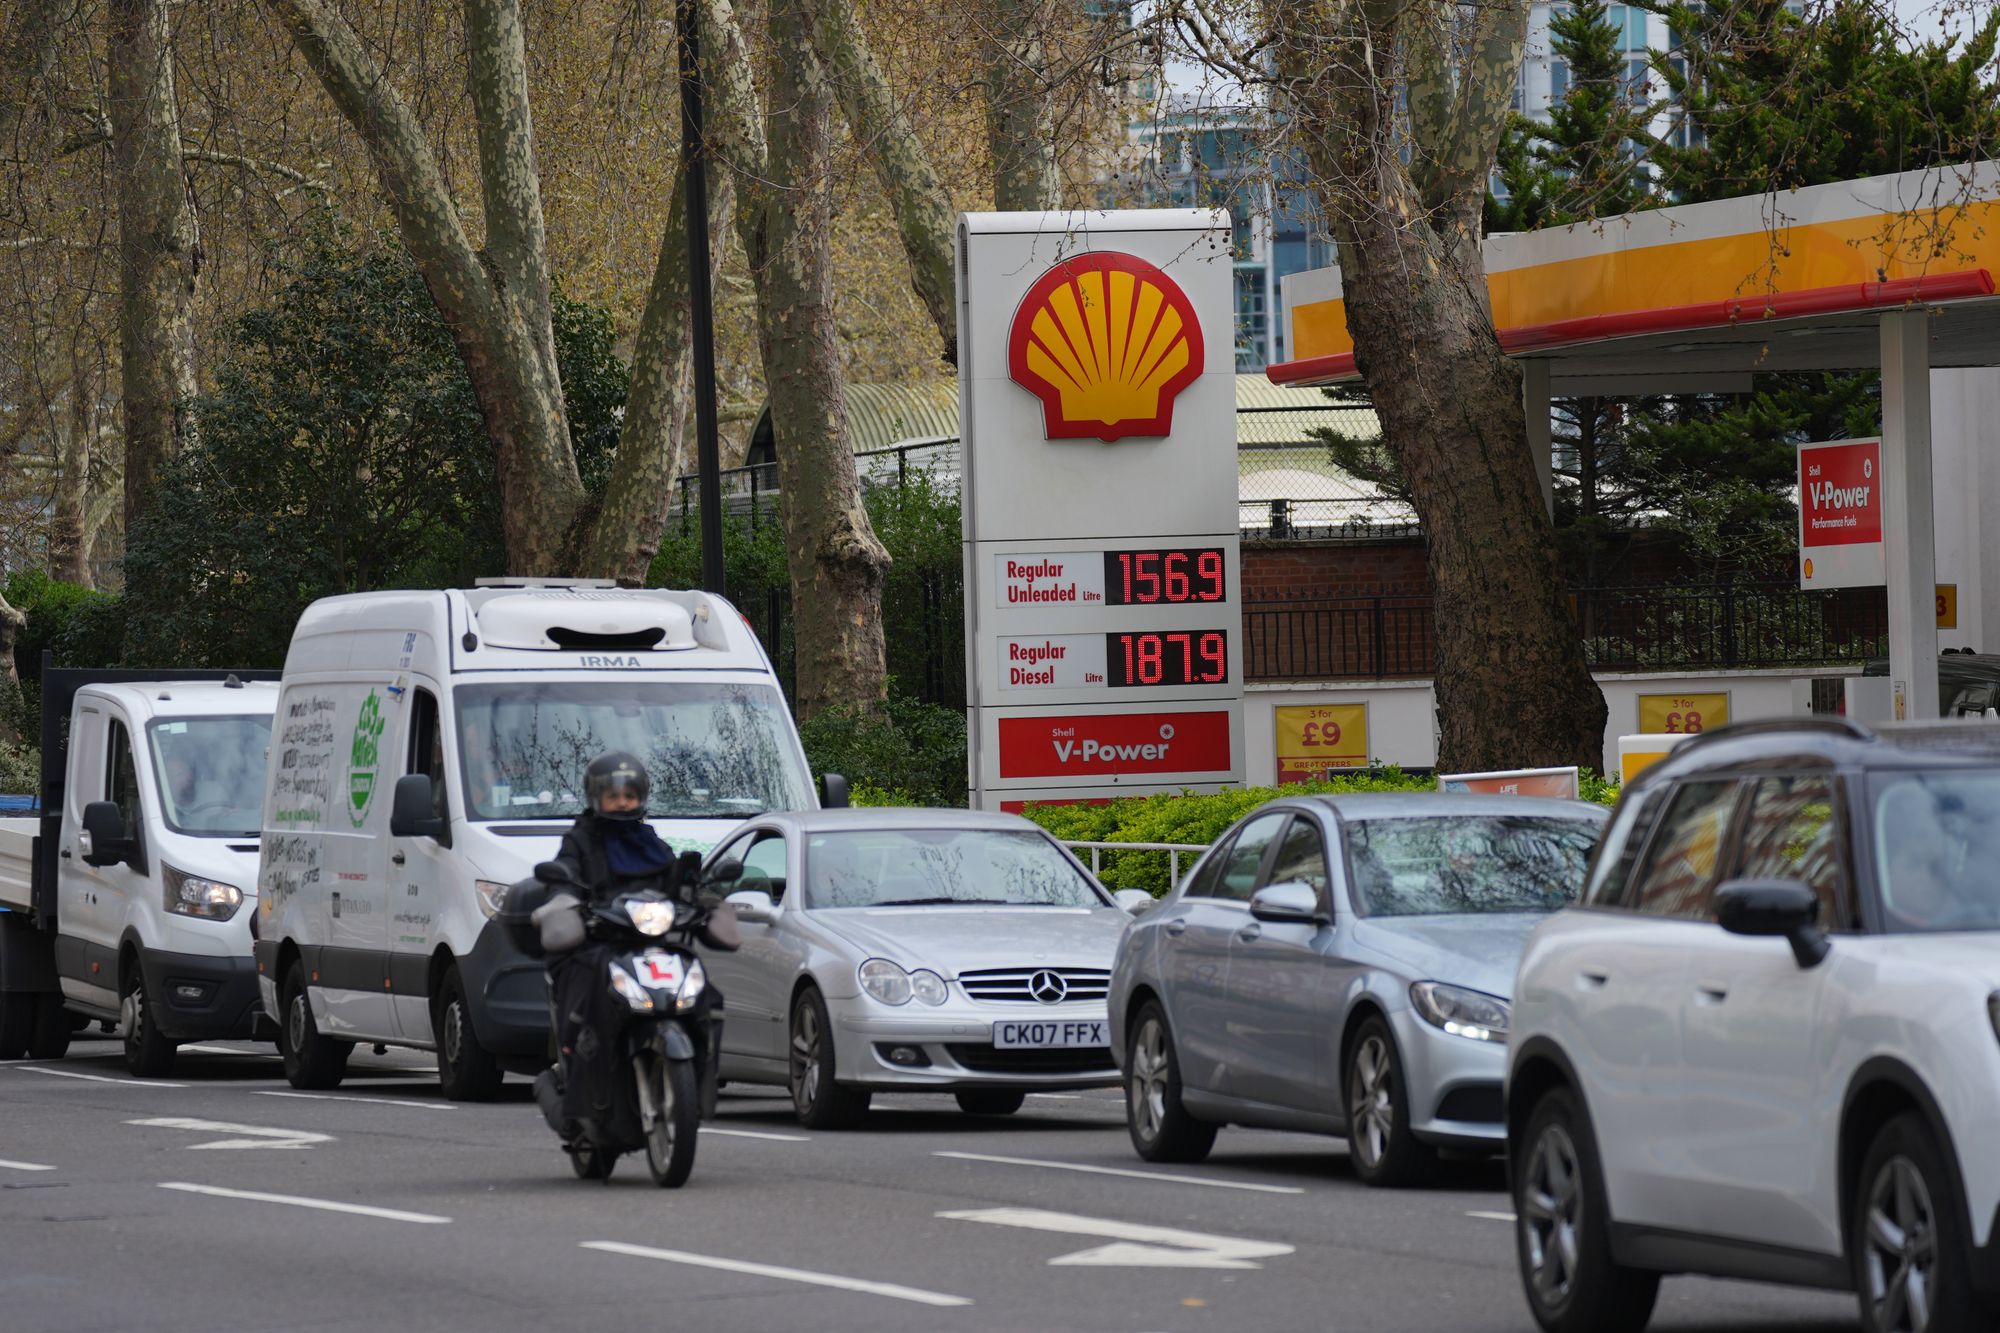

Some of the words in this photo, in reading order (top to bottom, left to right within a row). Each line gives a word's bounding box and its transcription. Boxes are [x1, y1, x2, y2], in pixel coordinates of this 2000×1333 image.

[1809, 465, 1821, 477] Shell
[1809, 481, 1870, 510] V-Power
[1811, 516, 1844, 529] Performance
[1844, 514, 1857, 527] Fuels
[1007, 559, 1064, 583] Regular
[1118, 551, 1223, 603] 156.9
[1008, 583, 1076, 603] Unleaded
[1083, 591, 1101, 601] Litre
[580, 656, 641, 667] IRMA
[1009, 641, 1066, 665] Regular
[1120, 633, 1225, 685] 187.9
[1010, 665, 1054, 685] Diesel
[1085, 673, 1103, 683] Litre
[1310, 710, 1316, 718] 3
[1318, 709, 1332, 718] for
[1672, 699, 1679, 708] 3
[1681, 699, 1695, 708] for
[1052, 728, 1075, 737] Shell
[1665, 711, 1703, 734] £8
[1302, 721, 1341, 747] £9
[1052, 739, 1169, 763] V-Power
[1320, 760, 1352, 768] OFFERS
[1500, 784, 1519, 794] LIFE
[649, 962, 673, 981] L
[1004, 1024, 1057, 1044] CK07
[1064, 1023, 1102, 1043] FFX
